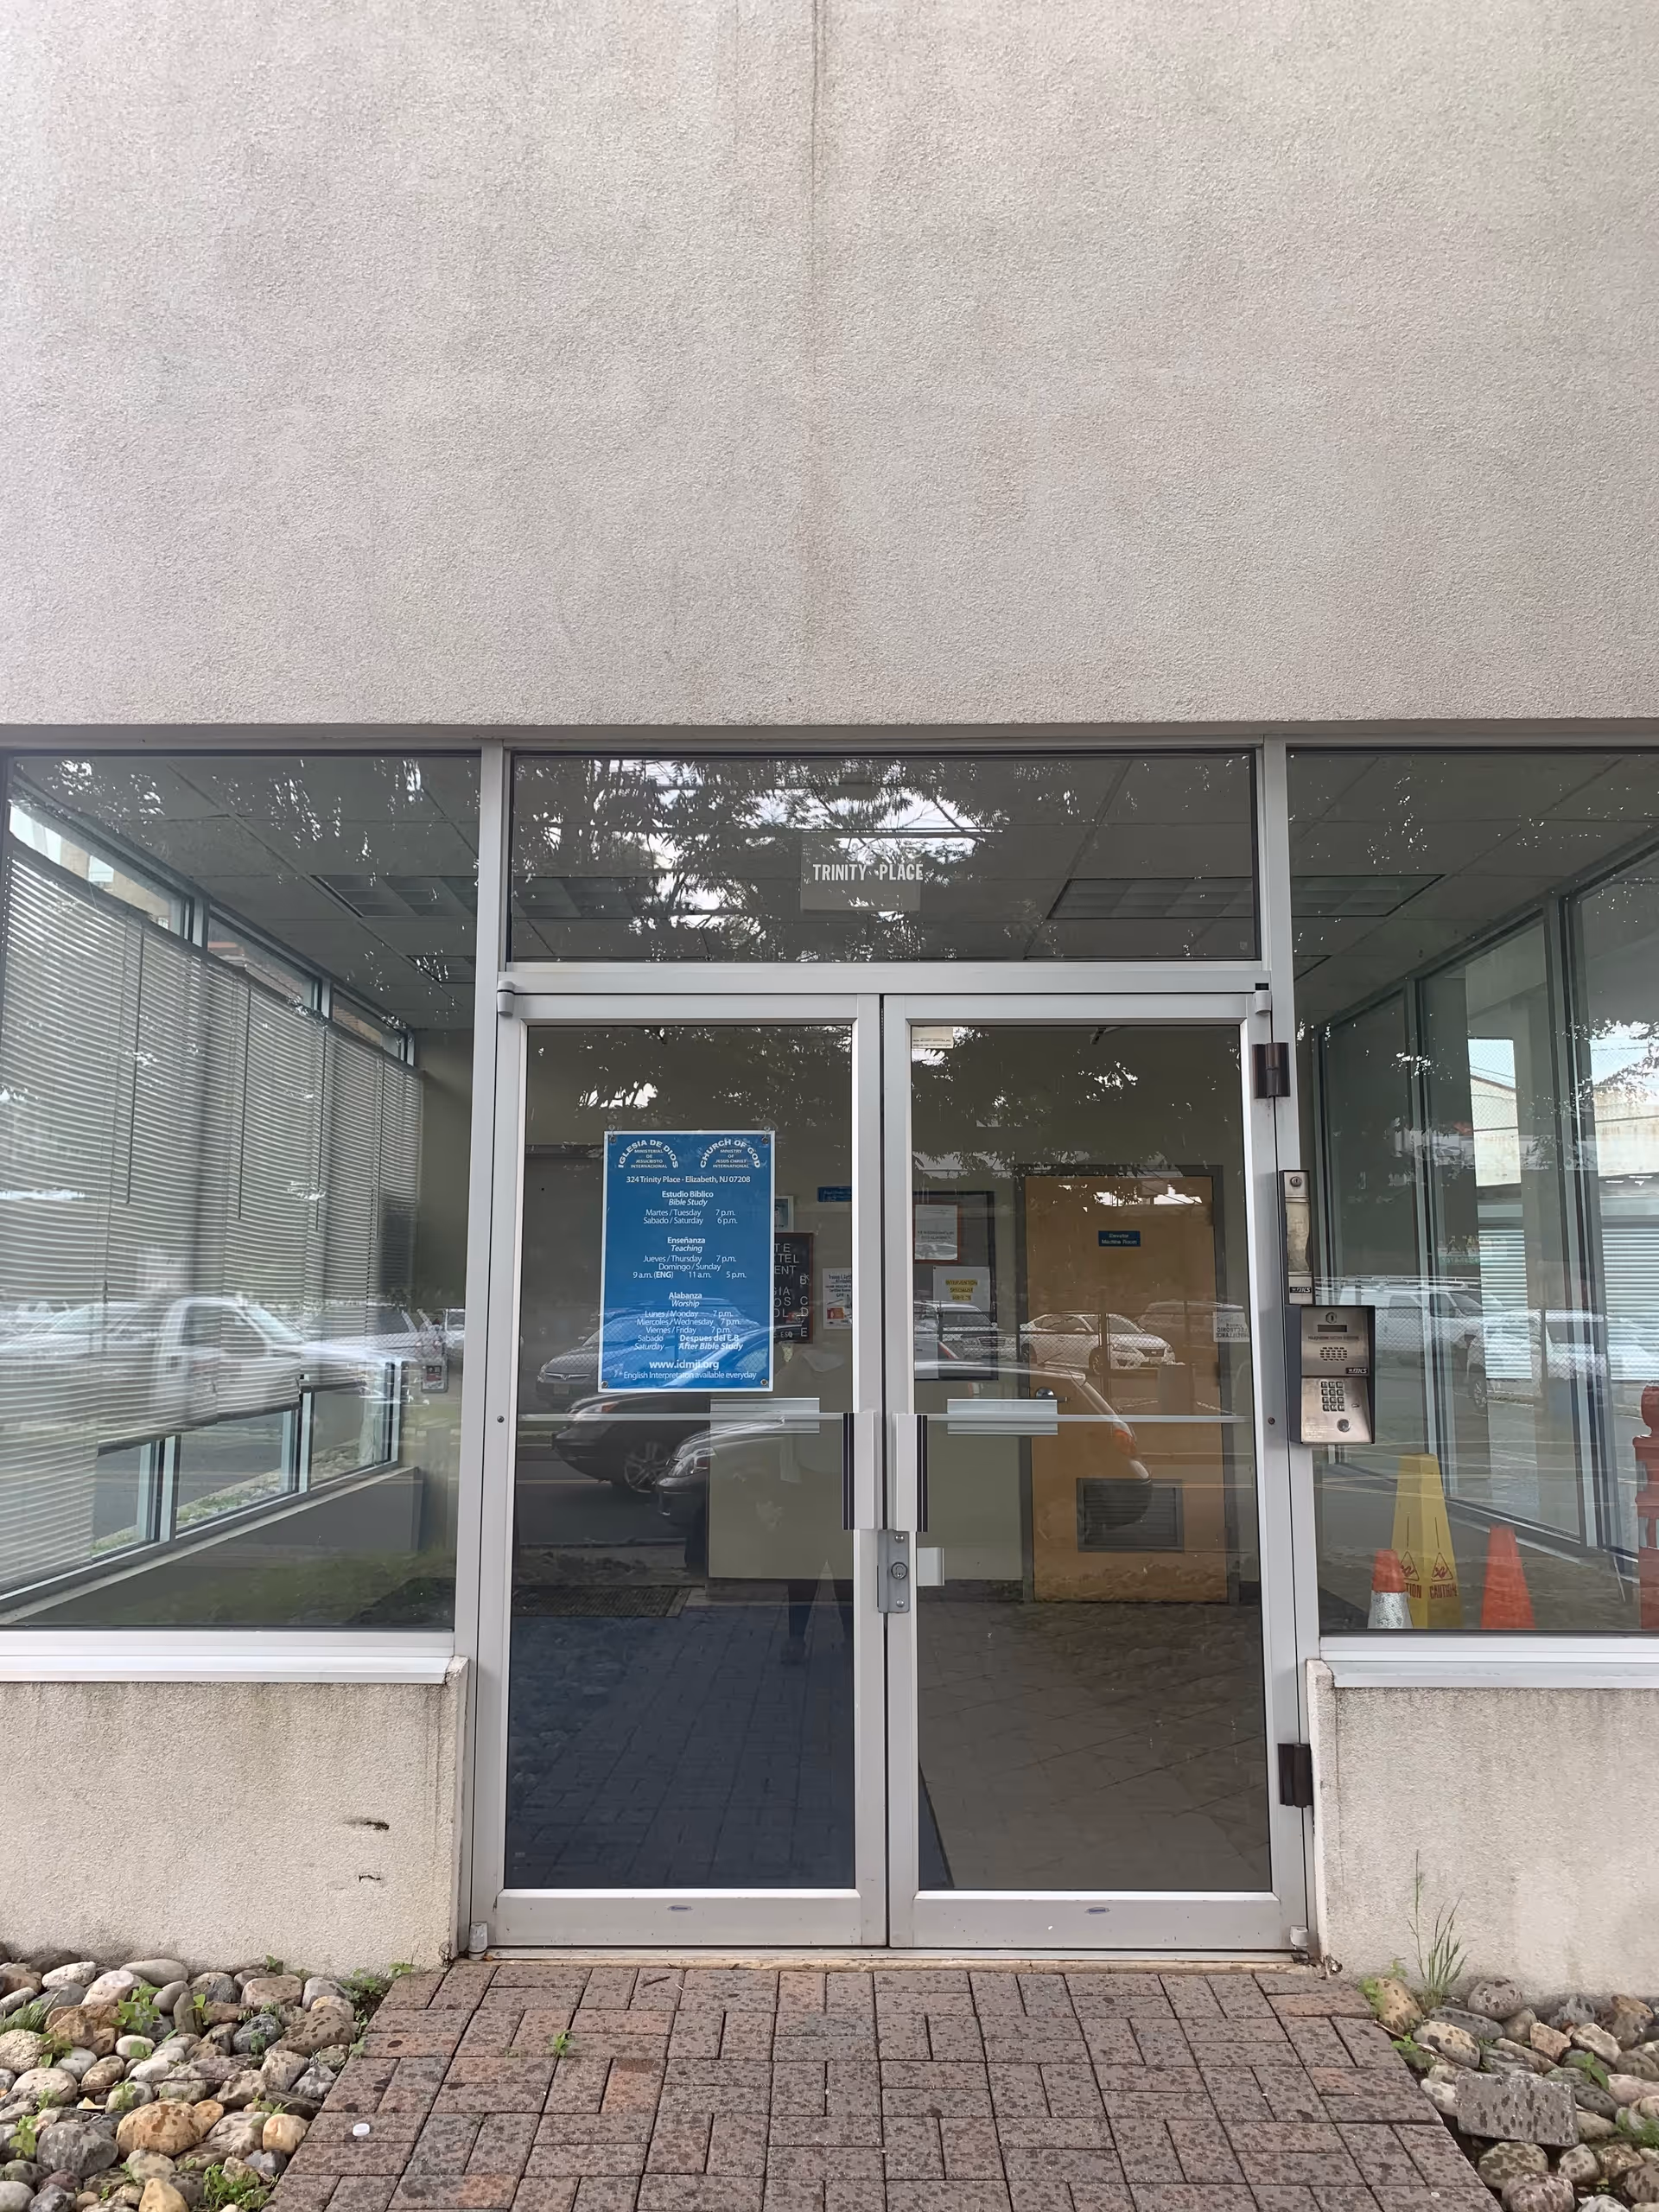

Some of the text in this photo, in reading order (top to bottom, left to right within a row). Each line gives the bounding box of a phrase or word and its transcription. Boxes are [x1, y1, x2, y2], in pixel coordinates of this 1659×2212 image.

[813, 864, 923, 880] TRINITY PLACE
[618, 1140, 647, 1168] IGLESIA
[664, 1145, 679, 1168] DIOS
[700, 1139, 761, 1168] CHURCH OF GOD
[671, 1255, 702, 1264] Thursday
[800, 1296, 808, 1306] C
[801, 1328, 807, 1337] E
[650, 1360, 719, 1370] www.idmji.org
